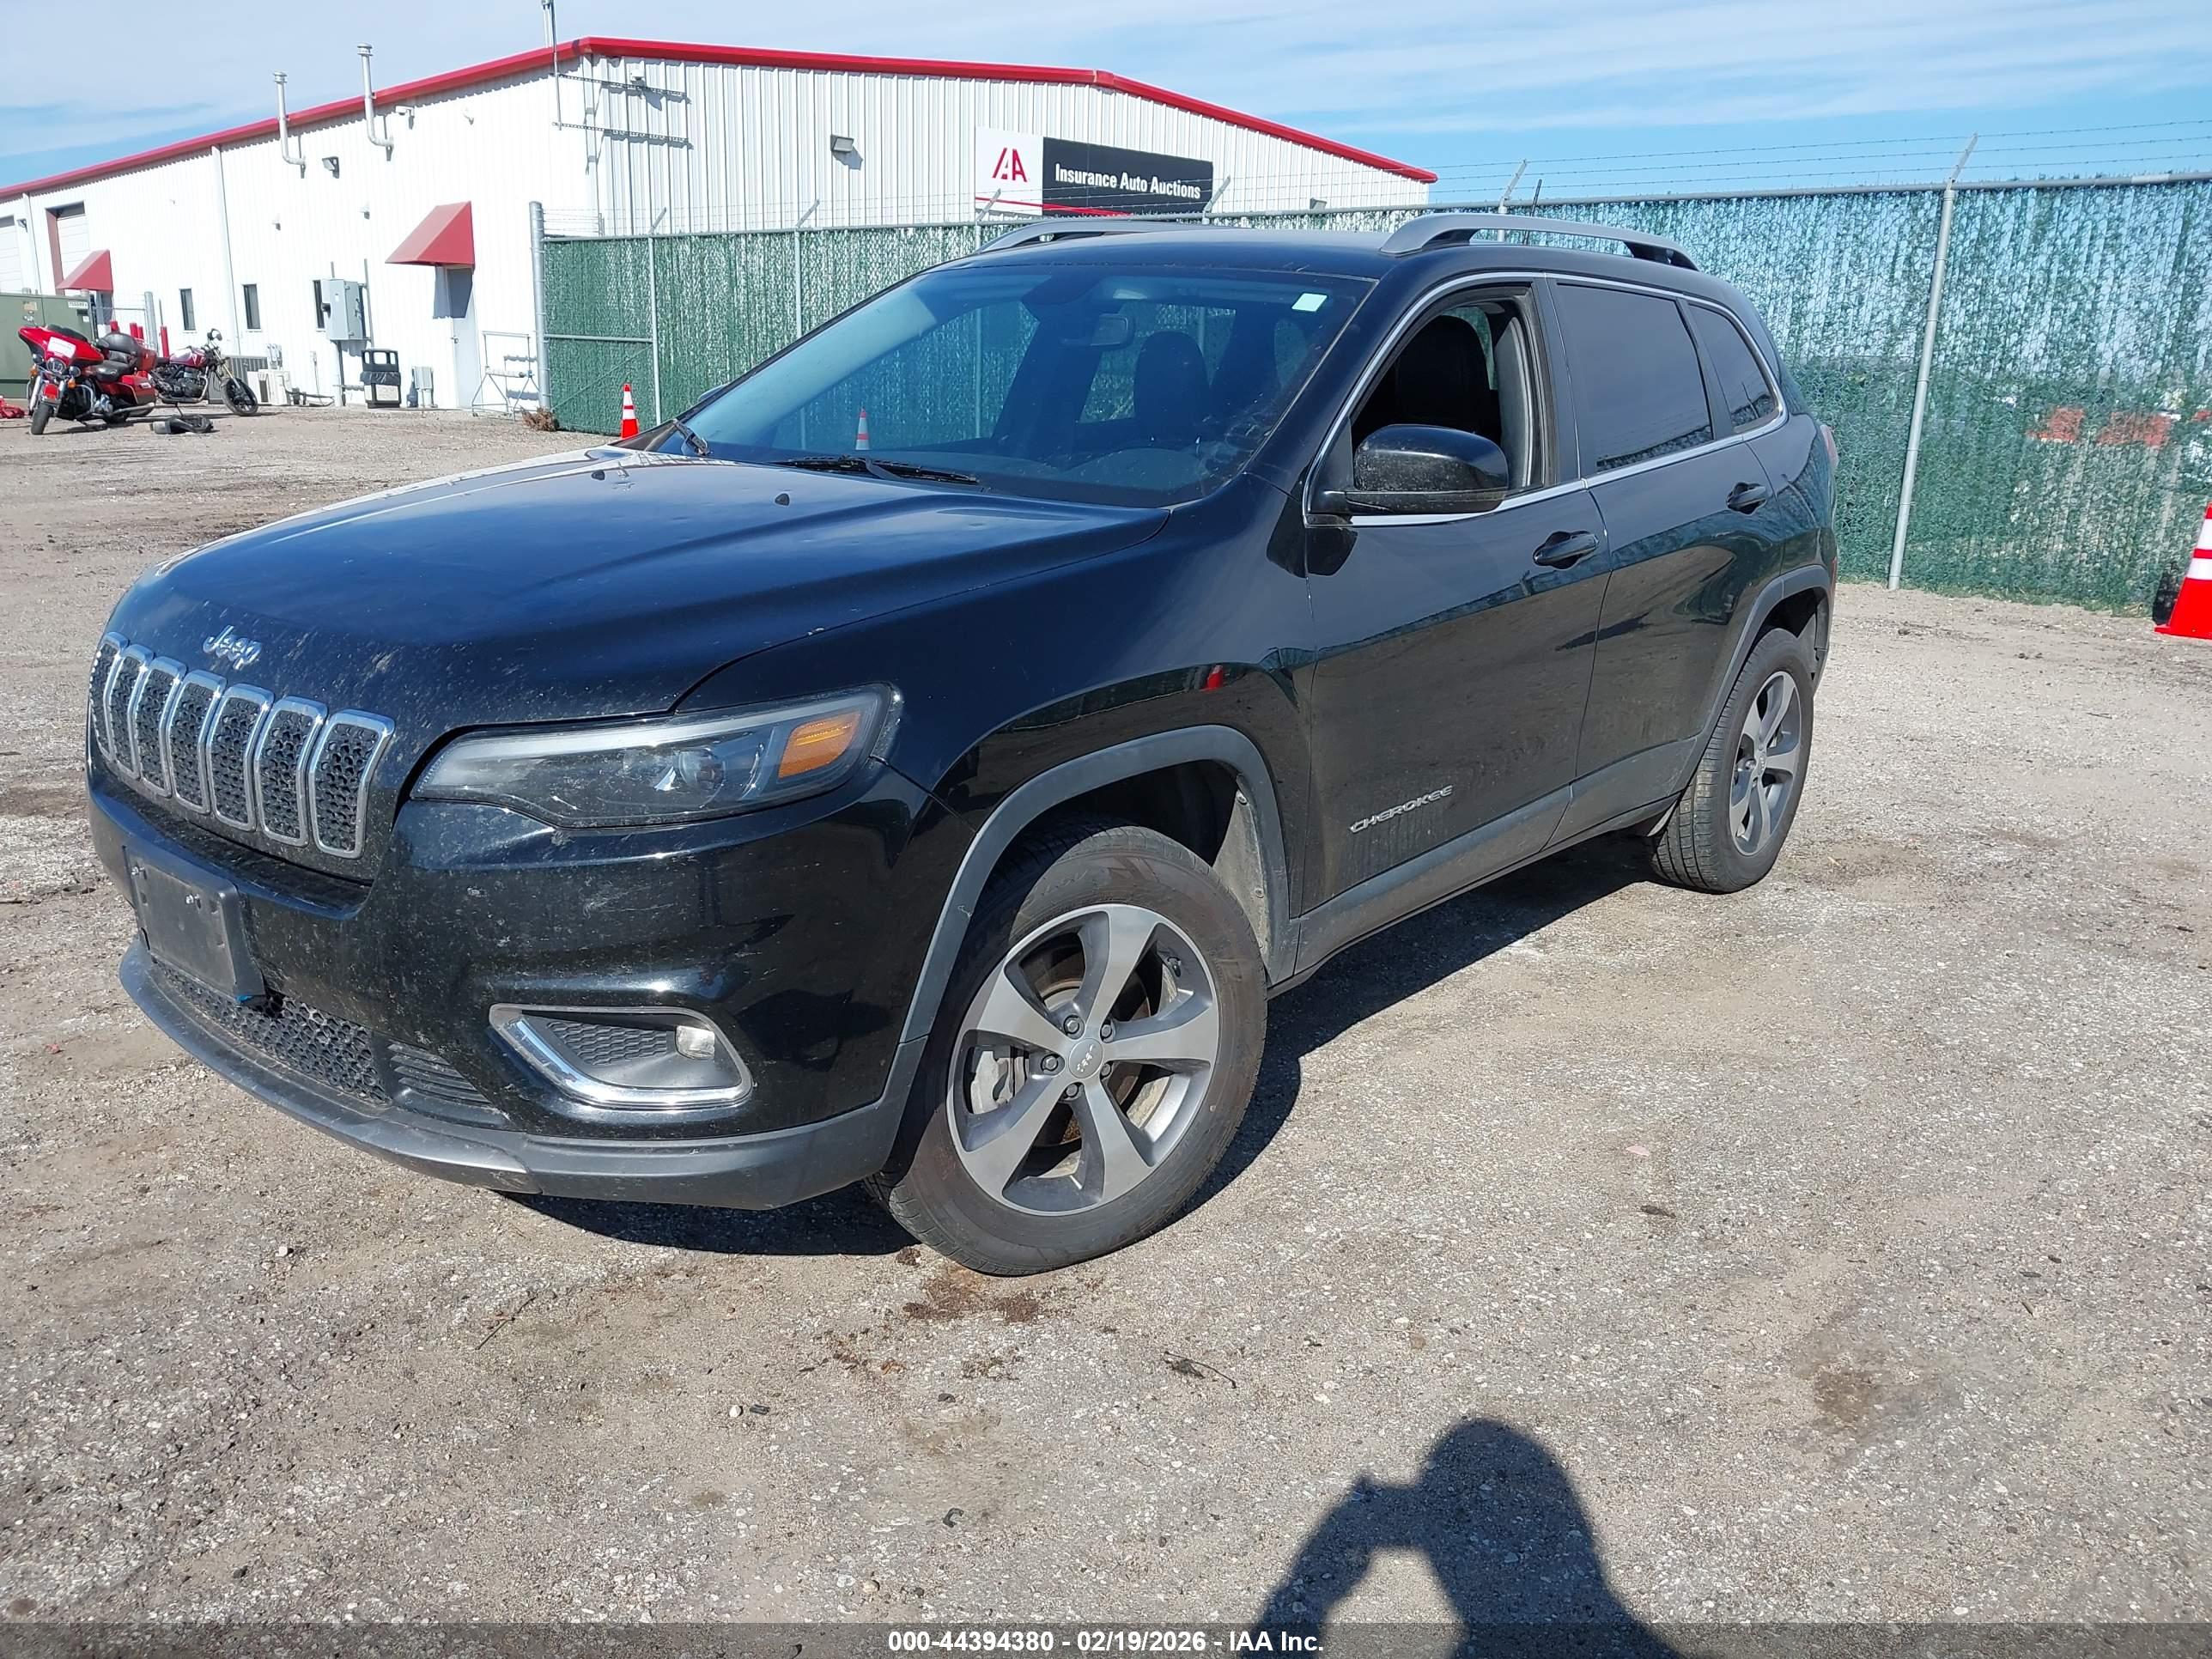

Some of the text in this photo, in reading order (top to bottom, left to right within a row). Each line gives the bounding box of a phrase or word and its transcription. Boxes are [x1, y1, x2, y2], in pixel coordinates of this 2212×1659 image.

[1055, 163, 1200, 199] Insurance Auto Auctions
[203, 624, 262, 670] Jeep
[1350, 785, 1453, 834] CHEROKEE
